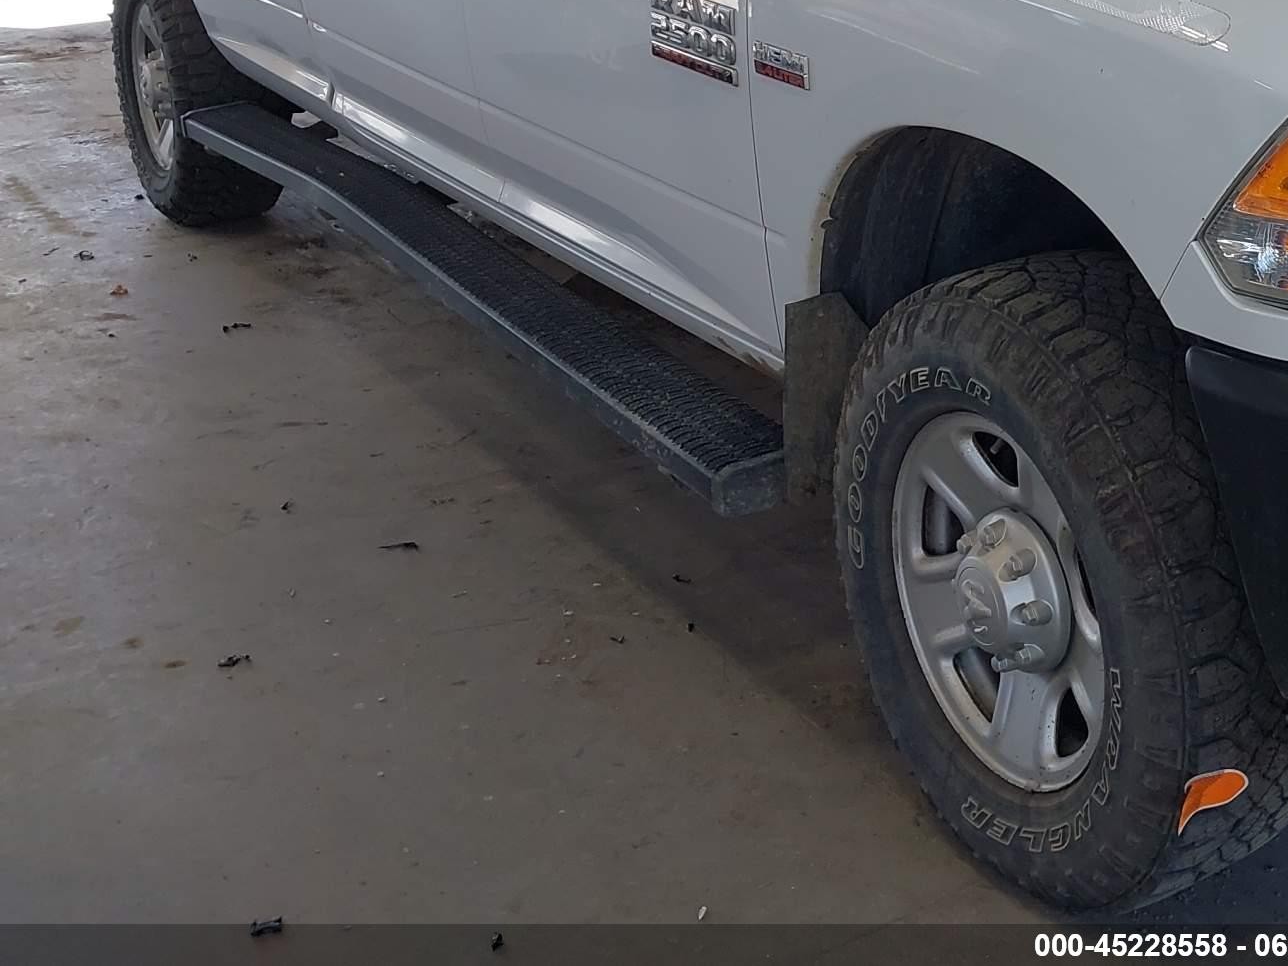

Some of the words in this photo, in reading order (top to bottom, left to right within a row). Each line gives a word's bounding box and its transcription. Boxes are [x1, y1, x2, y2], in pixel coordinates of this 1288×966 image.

[650, 11, 737, 65] 2500
[752, 40, 809, 75] HEMI
[847, 366, 991, 570] GOODYEAR
[960, 667, 1123, 853] WRANGLER
